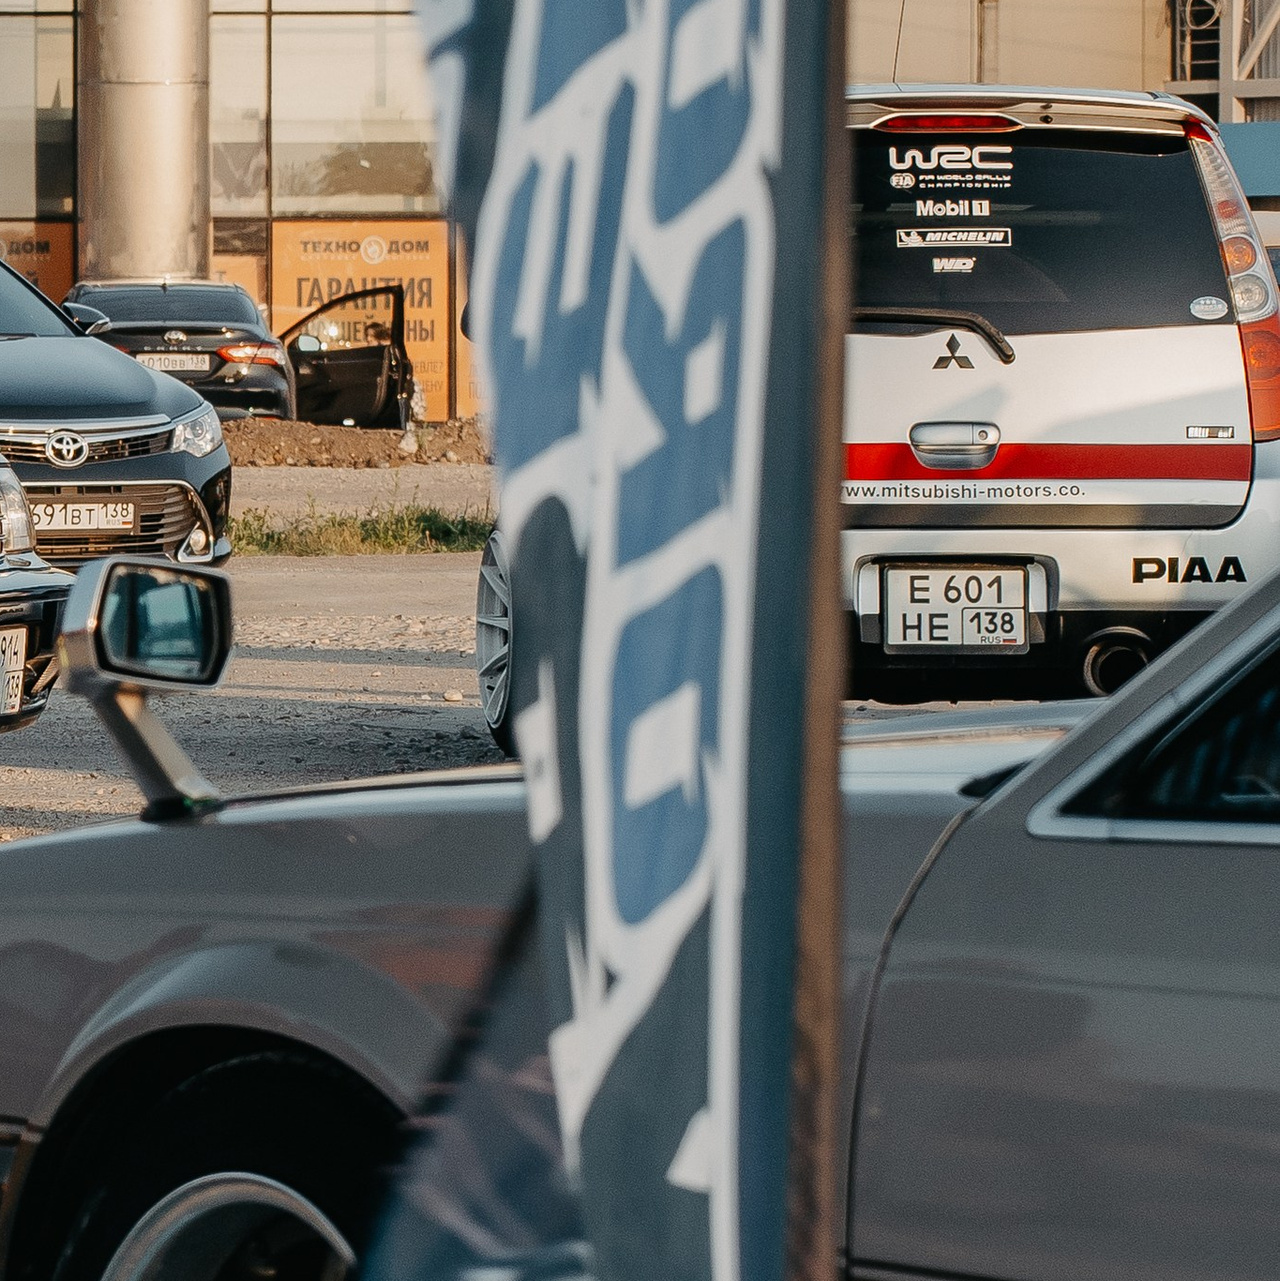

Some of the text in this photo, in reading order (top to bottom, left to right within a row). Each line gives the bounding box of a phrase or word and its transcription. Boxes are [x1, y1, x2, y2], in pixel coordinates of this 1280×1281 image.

[888, 145, 1013, 169] WRC
[915, 199, 970, 216] Mobil
[300, 240, 430, 254] ТЕХНО ДОМ
[925, 231, 1005, 242] MICHELIN
[296, 276, 432, 311] ГАРАНТИЯ
[100, 502, 129, 518] 138
[1131, 556, 1247, 584] PIAA
[944, 575, 1003, 605] 601
[969, 611, 1015, 634] 138
[980, 636, 1001, 645] RUS
[4, 675, 20, 701] 138
